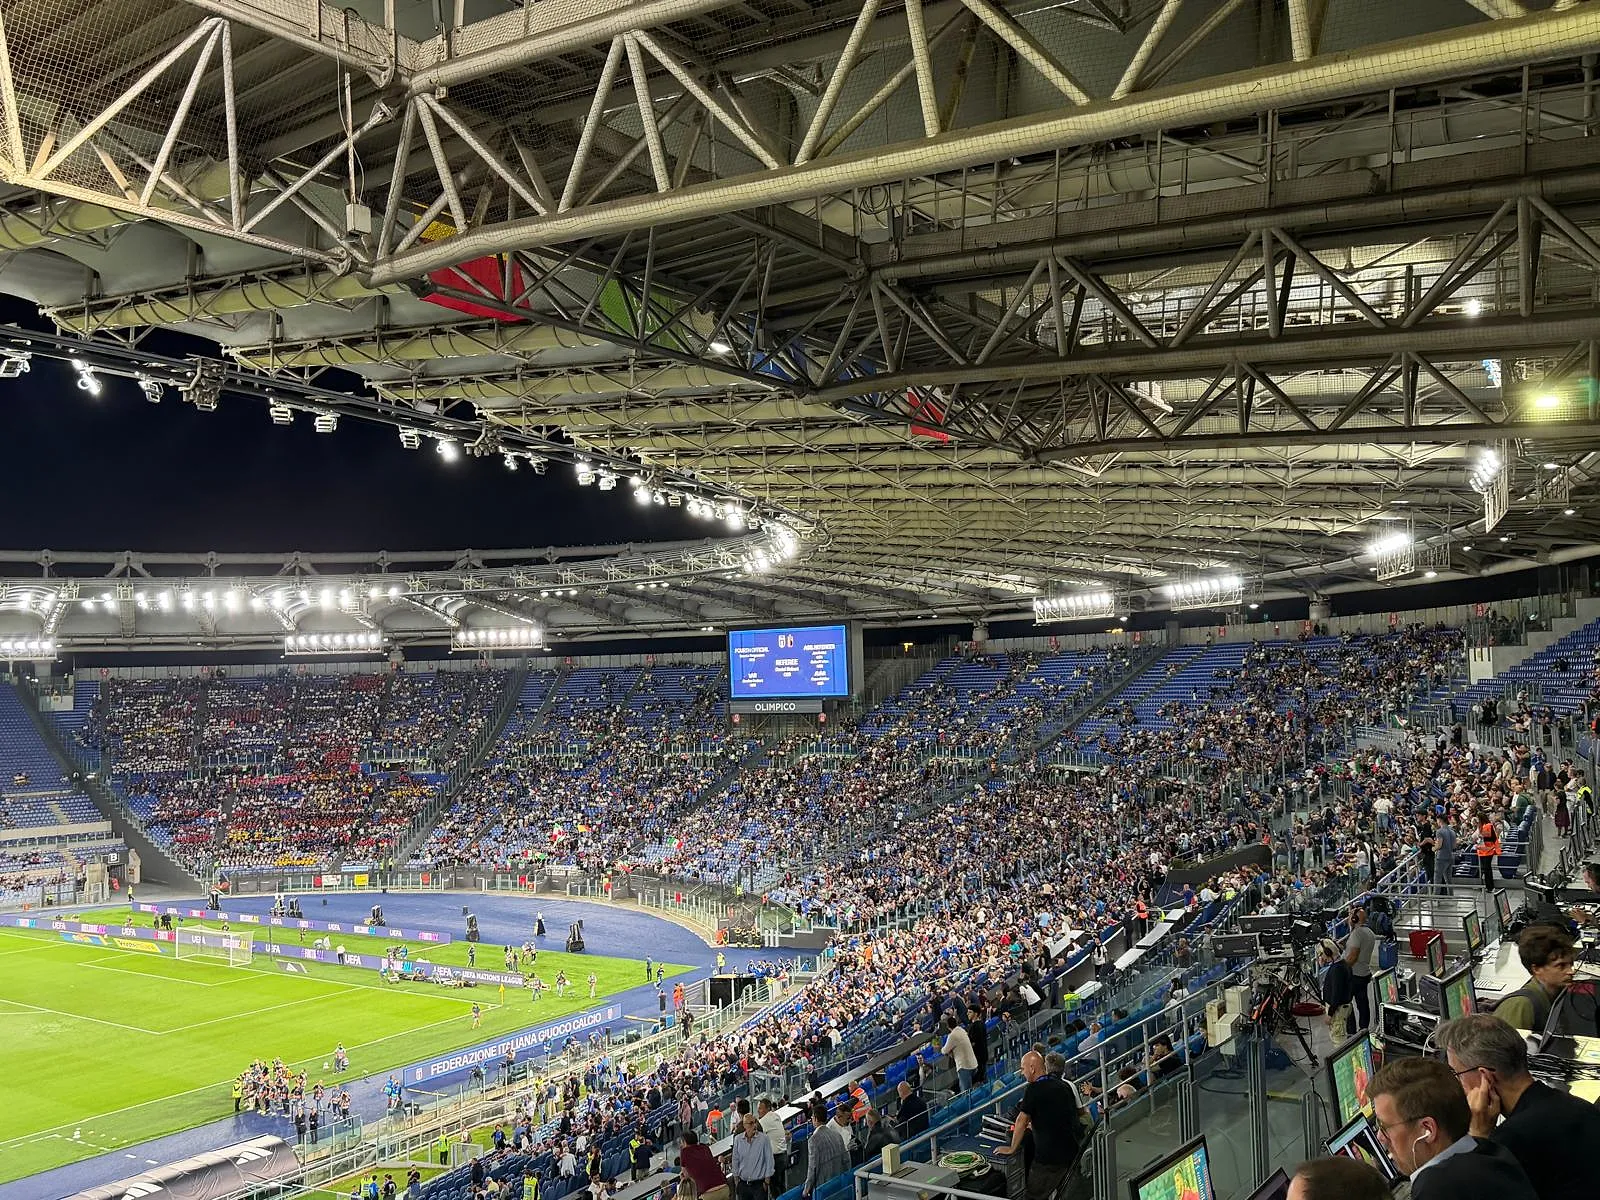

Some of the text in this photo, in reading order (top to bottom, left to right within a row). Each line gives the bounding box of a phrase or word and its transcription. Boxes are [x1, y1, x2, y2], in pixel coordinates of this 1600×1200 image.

[755, 703, 796, 711] OLIMPICO
[52, 921, 66, 930] UEFA
[121, 927, 137, 937] UEFA
[344, 954, 362, 966] UEFA
[462, 970, 476, 979] UEFA
[476, 972, 501, 982] NATIONS
[430, 1011, 602, 1076] FEDERAZIONE ITALIANA GIUOCO CALCIO
